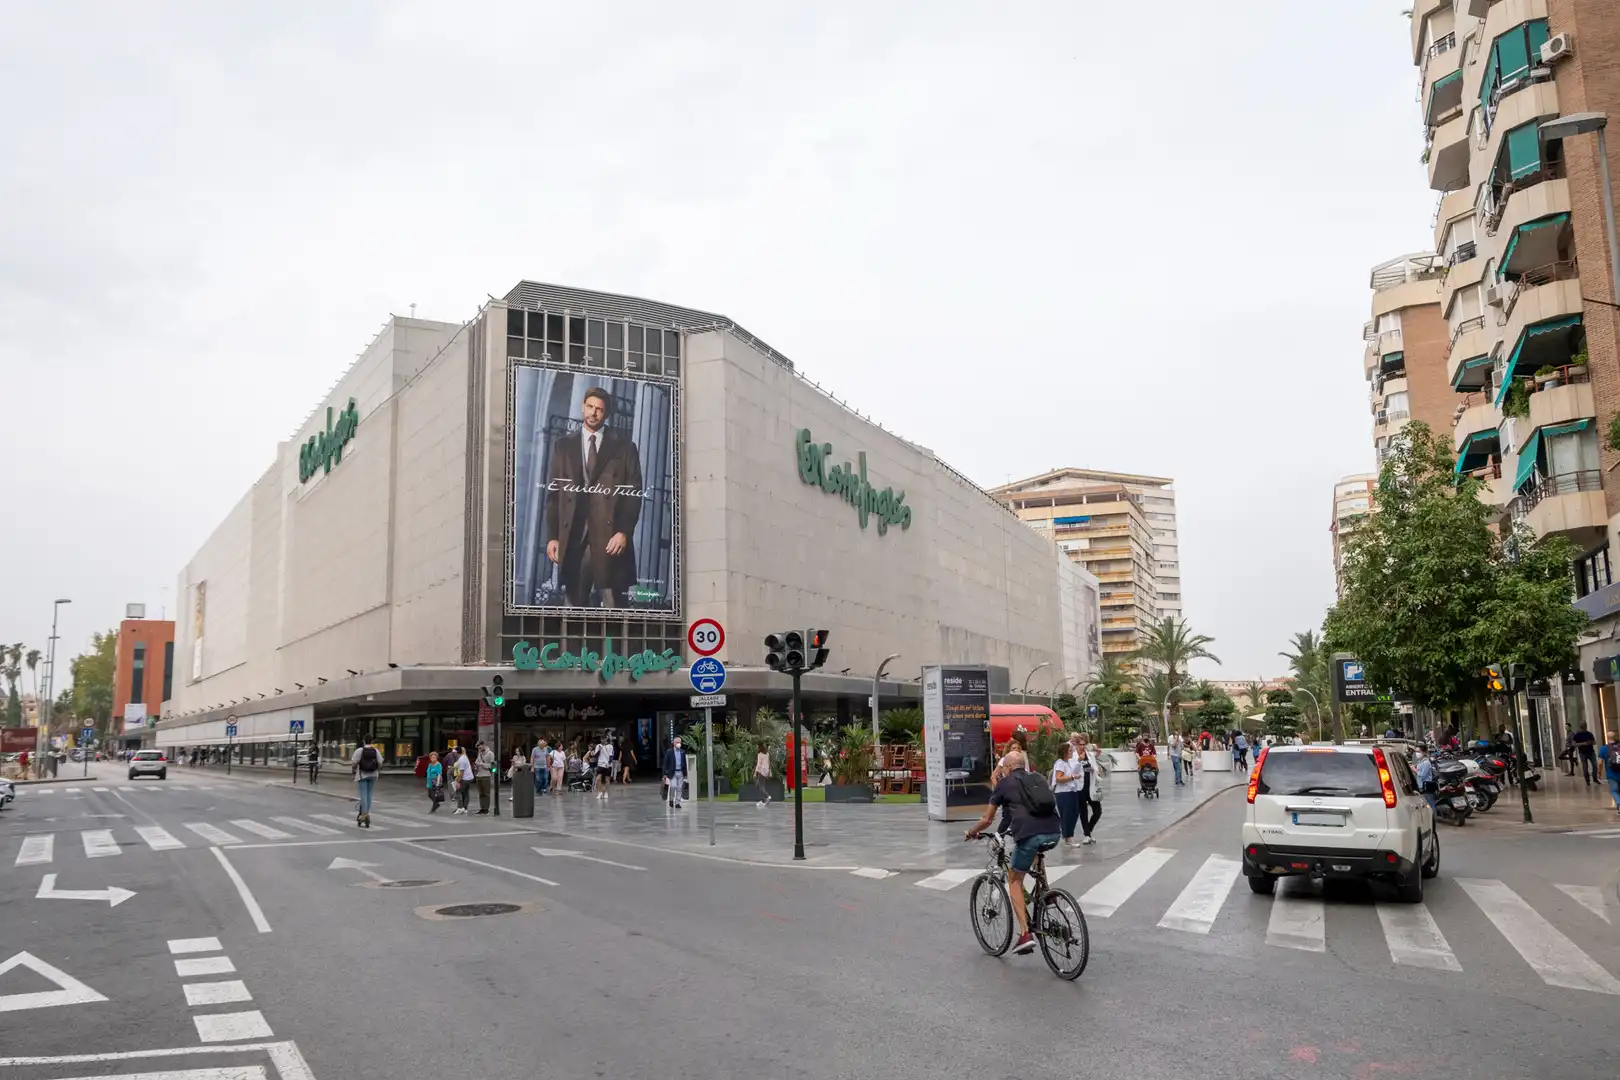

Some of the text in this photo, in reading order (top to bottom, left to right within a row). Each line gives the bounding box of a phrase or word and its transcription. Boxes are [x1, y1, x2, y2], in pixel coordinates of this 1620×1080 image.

[612, 484, 651, 498] Tucci
[796, 428, 912, 537] El Corte Inglés
[696, 630, 717, 643] 30
[512, 636, 683, 681] El Corte Inglés
[523, 703, 605, 720] El Corte Inglés
